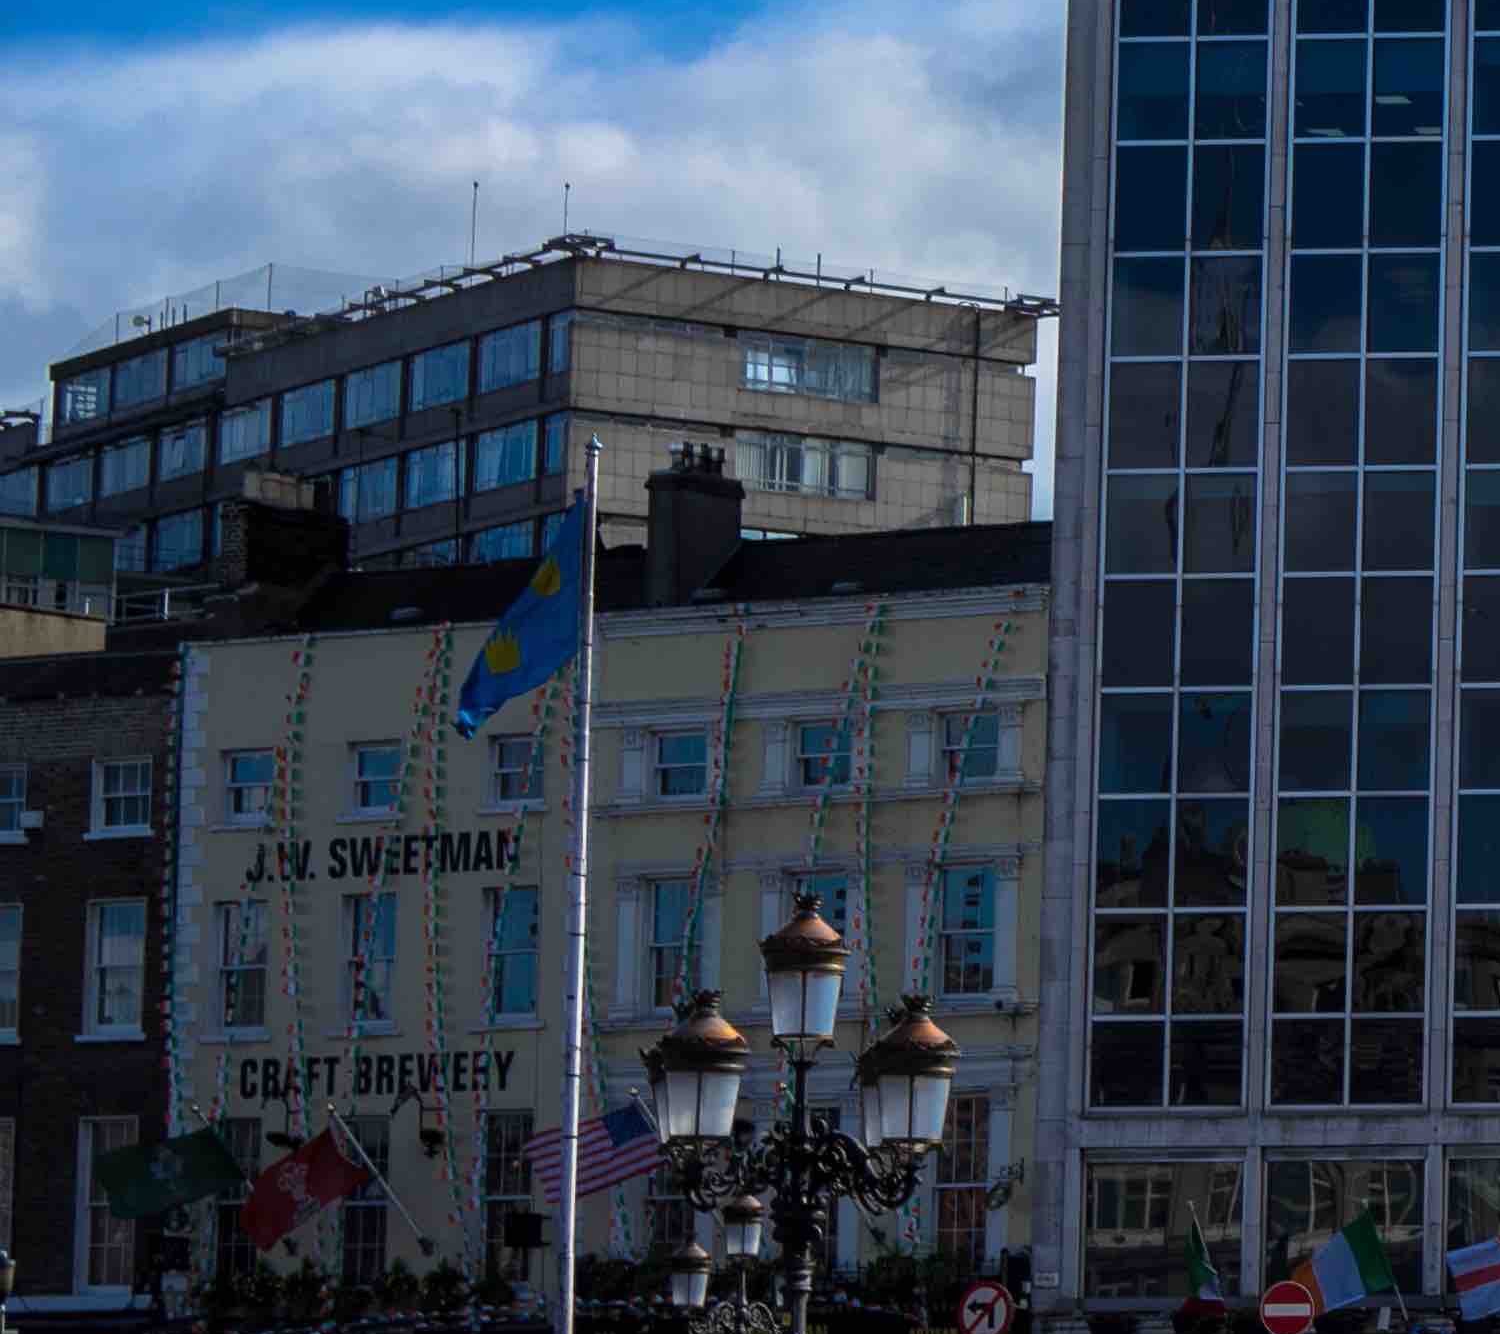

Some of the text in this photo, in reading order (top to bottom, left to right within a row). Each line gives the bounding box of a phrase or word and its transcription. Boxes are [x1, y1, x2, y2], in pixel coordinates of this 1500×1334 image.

[246, 829, 522, 883] J.W. SWEETMAN
[239, 1049, 514, 1099] CRAFT BREWERY
